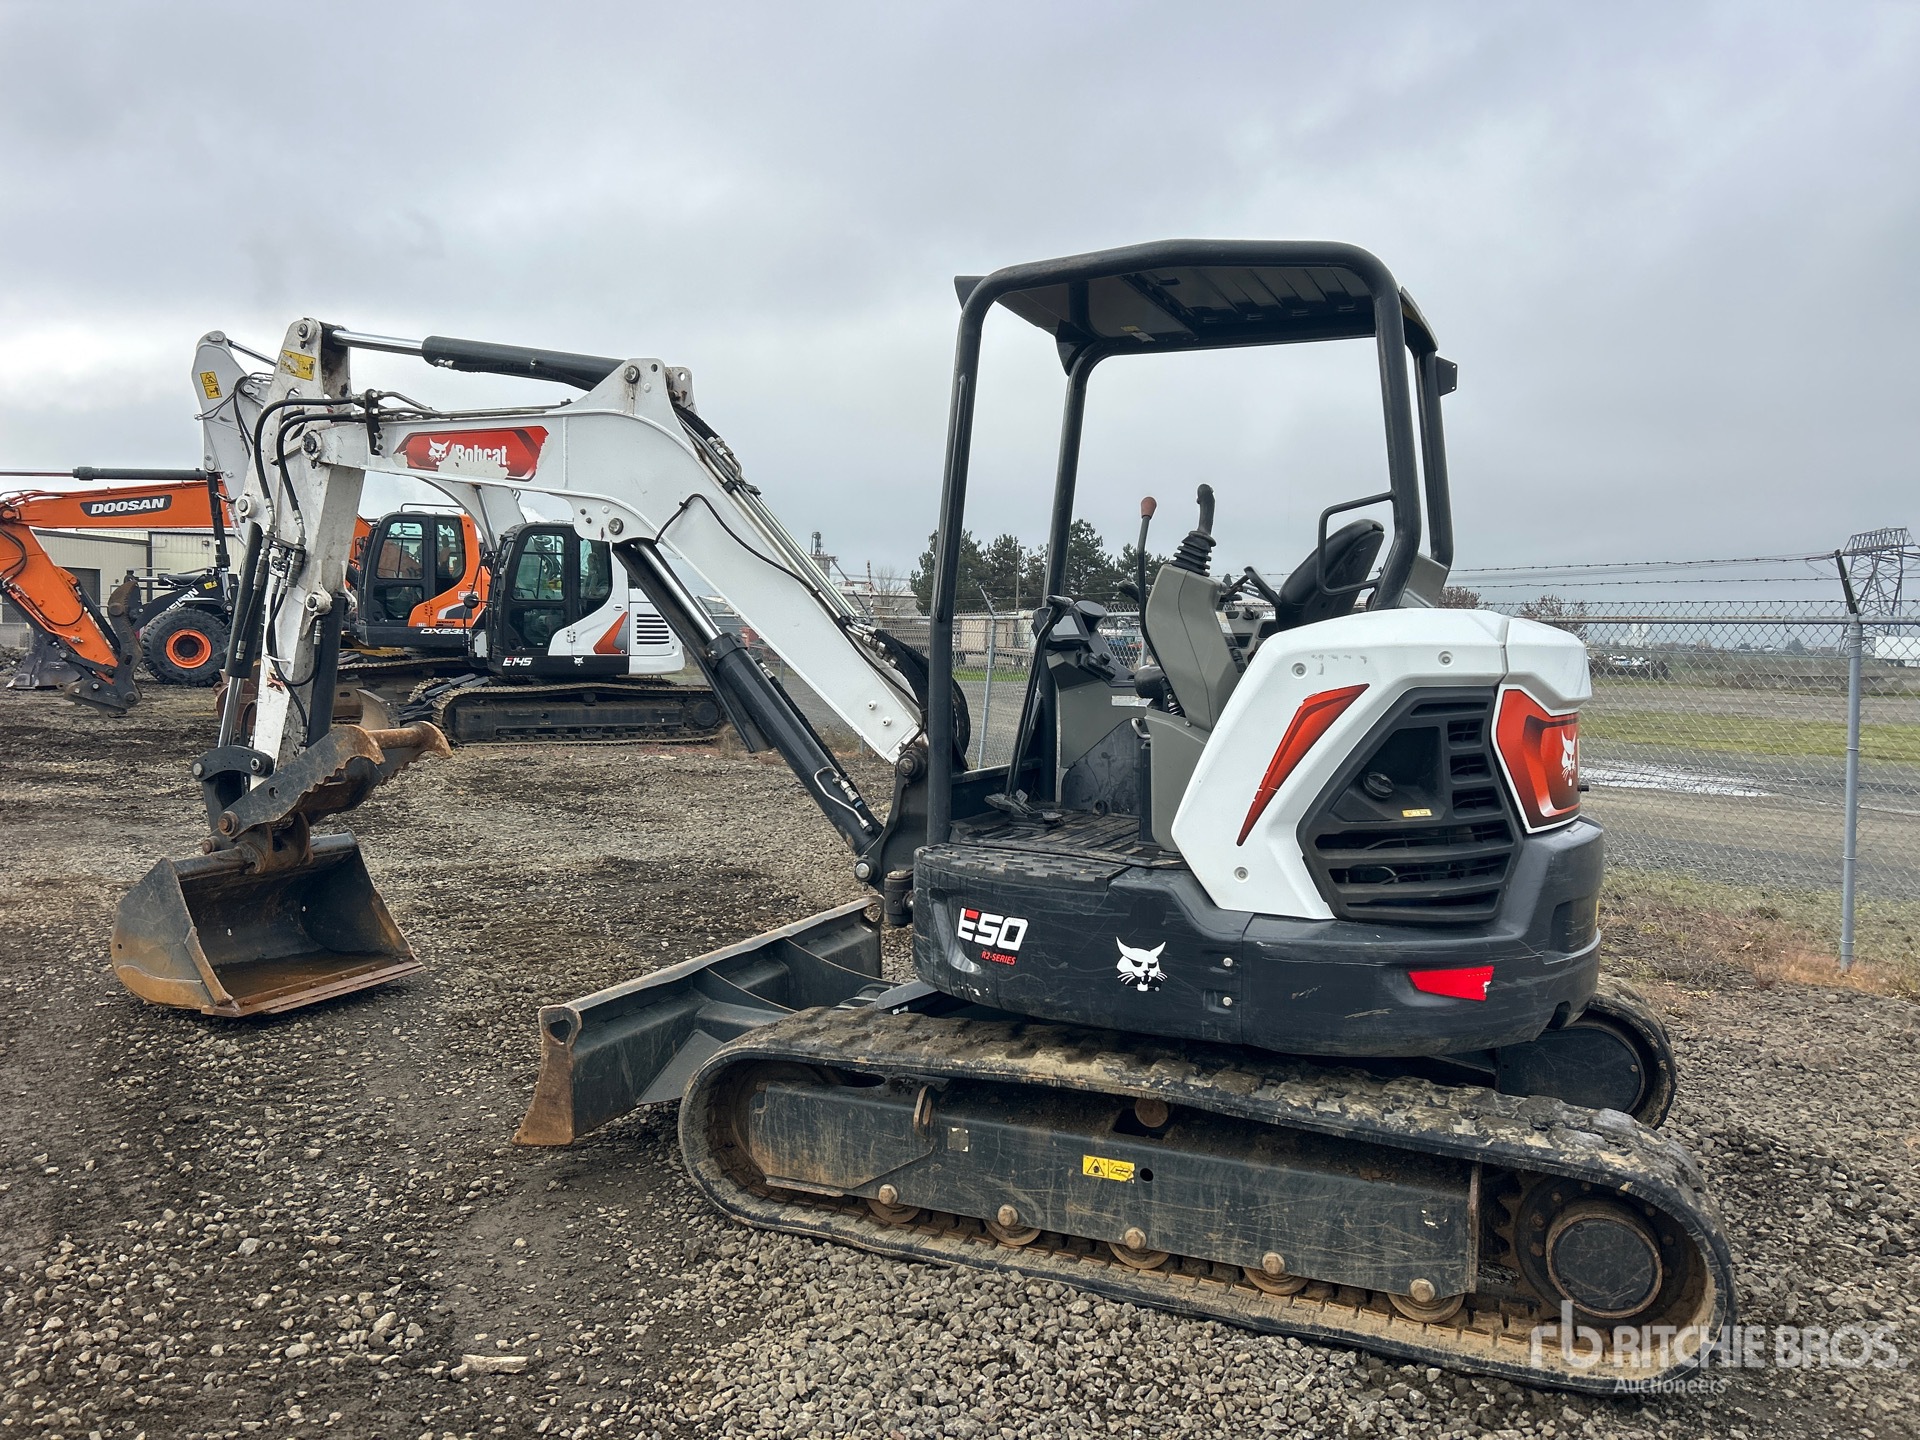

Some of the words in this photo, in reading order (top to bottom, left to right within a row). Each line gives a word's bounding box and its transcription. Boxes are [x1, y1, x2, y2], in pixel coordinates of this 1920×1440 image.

[455, 444, 508, 465] Bobcat
[90, 498, 165, 514] DOOSAN
[502, 656, 533, 667] E145
[957, 907, 1029, 951] E50
[981, 950, 1016, 966] R2-SERIES
